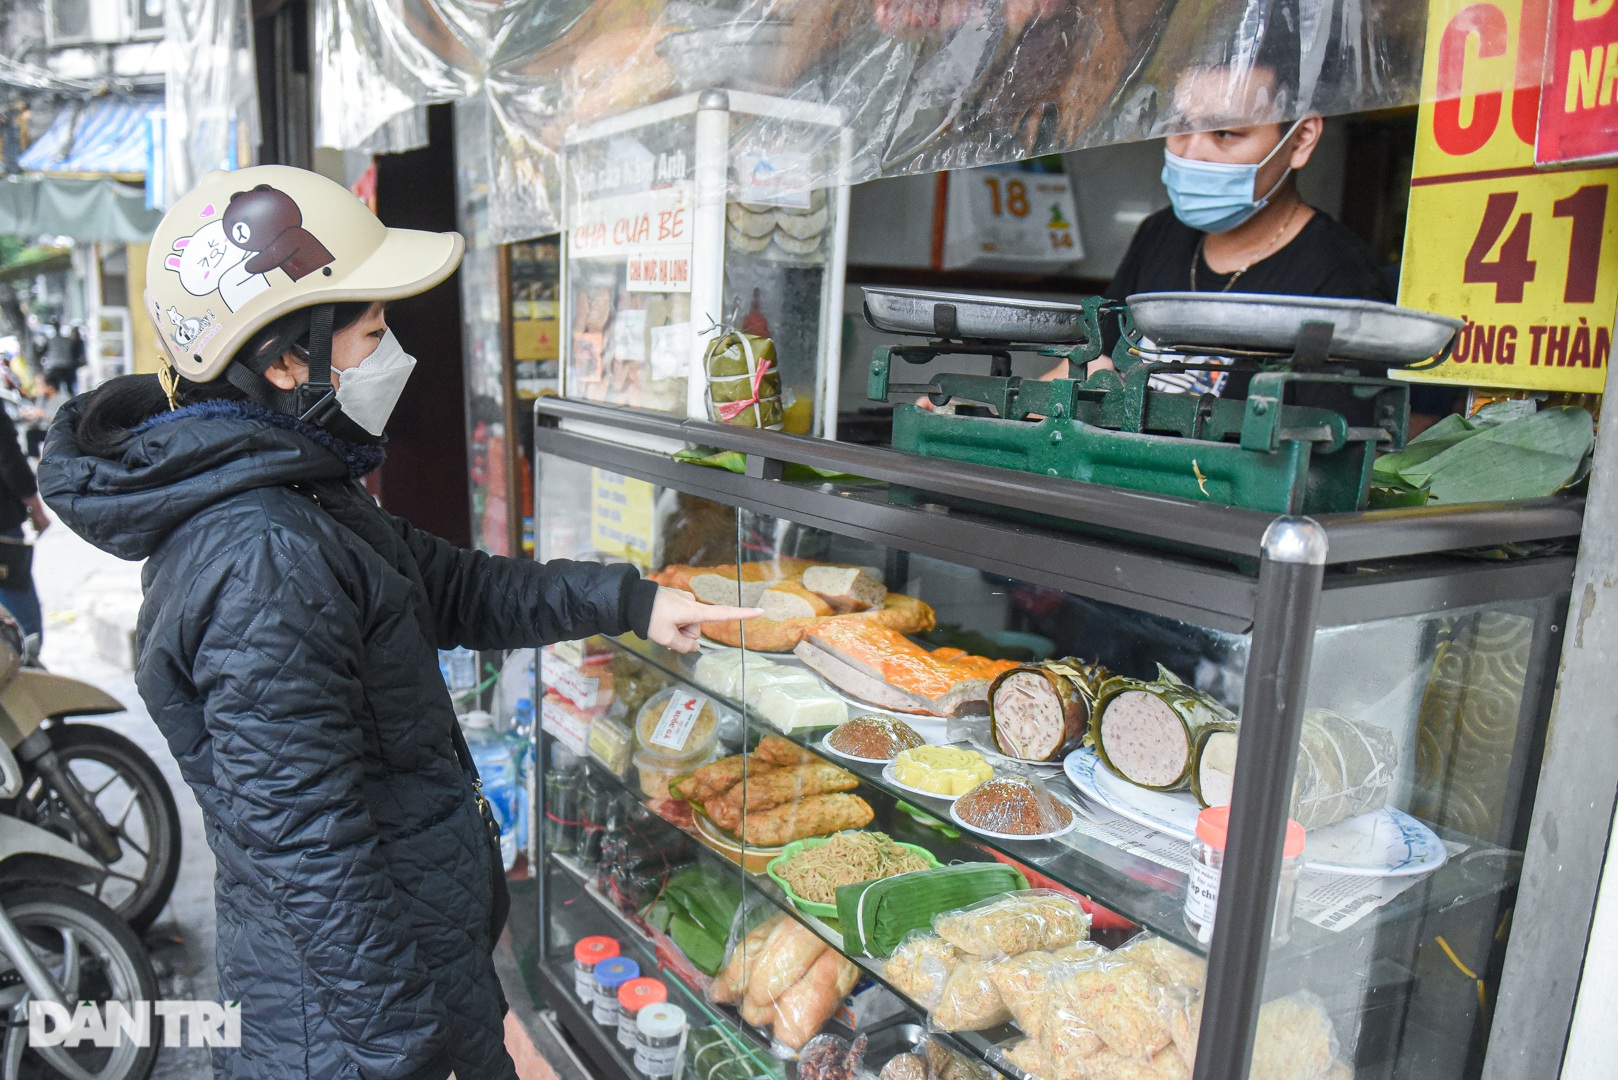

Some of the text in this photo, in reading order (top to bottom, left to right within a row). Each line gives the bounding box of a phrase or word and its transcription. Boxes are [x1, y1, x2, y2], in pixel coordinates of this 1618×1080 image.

[984, 177, 1031, 218] 18
[613, 213, 650, 245] CUA
[1463, 184, 1609, 304] 41
[1438, 317, 1518, 365] ỜNG
